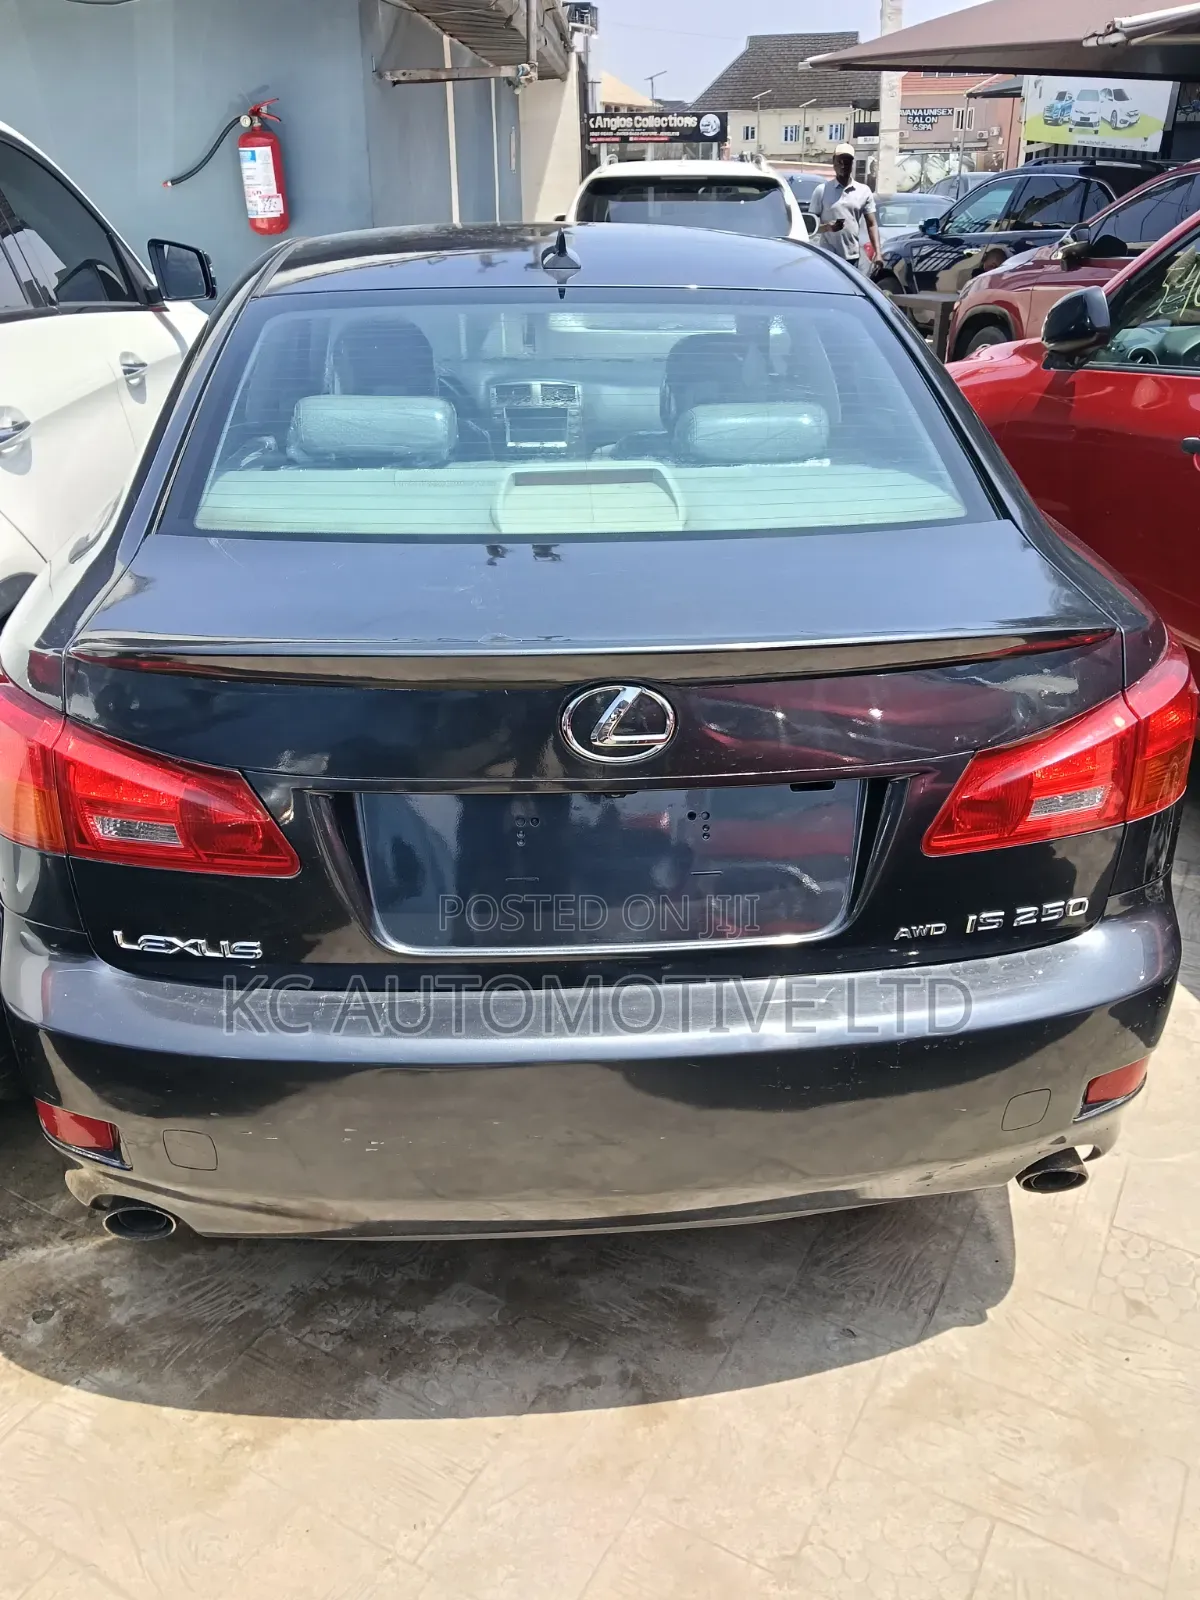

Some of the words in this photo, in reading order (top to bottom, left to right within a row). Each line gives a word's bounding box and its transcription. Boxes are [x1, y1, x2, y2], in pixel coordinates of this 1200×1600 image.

[907, 116, 938, 124] SALON
[923, 108, 953, 116] UNISEX
[634, 113, 698, 129] Collections
[894, 922, 947, 941] AWD
[965, 911, 1005, 933] IS
[1012, 897, 1090, 928] 250
[113, 930, 263, 960] LEXUS
